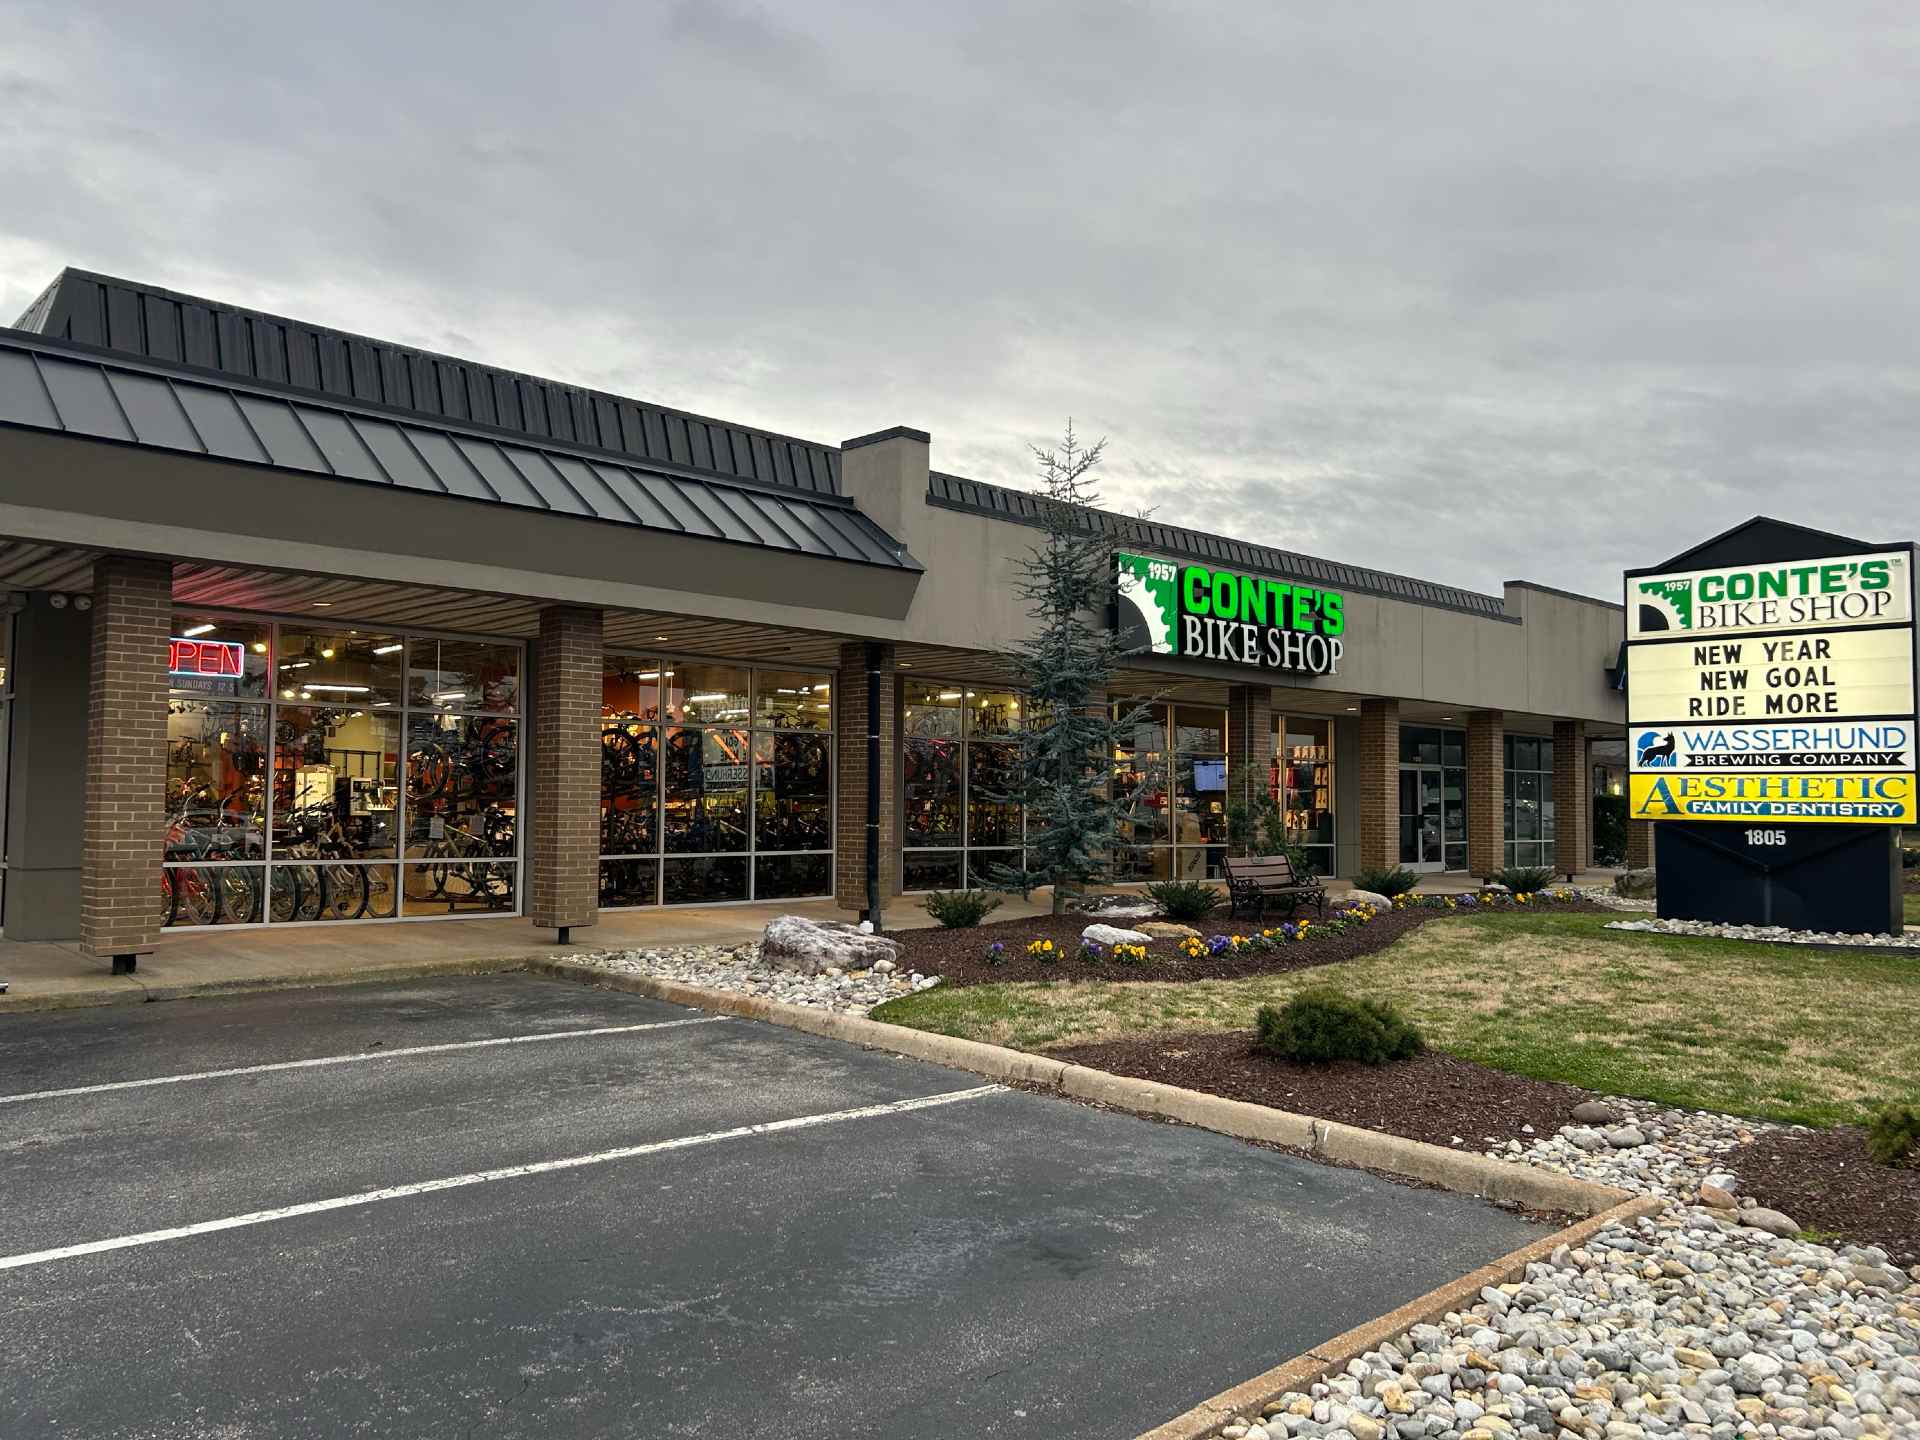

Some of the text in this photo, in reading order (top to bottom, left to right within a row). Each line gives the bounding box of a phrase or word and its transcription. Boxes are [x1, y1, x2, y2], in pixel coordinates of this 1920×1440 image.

[1148, 561, 1177, 582] 1957
[1698, 559, 1889, 603] CONTE'S
[1664, 579, 1691, 592] 1957
[1183, 565, 1345, 637] CONTE'S
[1696, 591, 1892, 630] BIKE SHOP
[1182, 614, 1344, 675] BIKE SHOP
[1694, 638, 1832, 666] NEW YEAR
[1700, 665, 1836, 691] NEW GOAL
[1688, 691, 1839, 717] RIDE MORE
[1682, 727, 1906, 752] WASSERHUND
[1694, 752, 1894, 766] BREWING COMPANY
[1636, 776, 1907, 815] AESTHETIC
[1692, 800, 1898, 816] FAMILY DENTISTRY
[1744, 829, 1787, 846] 1805
